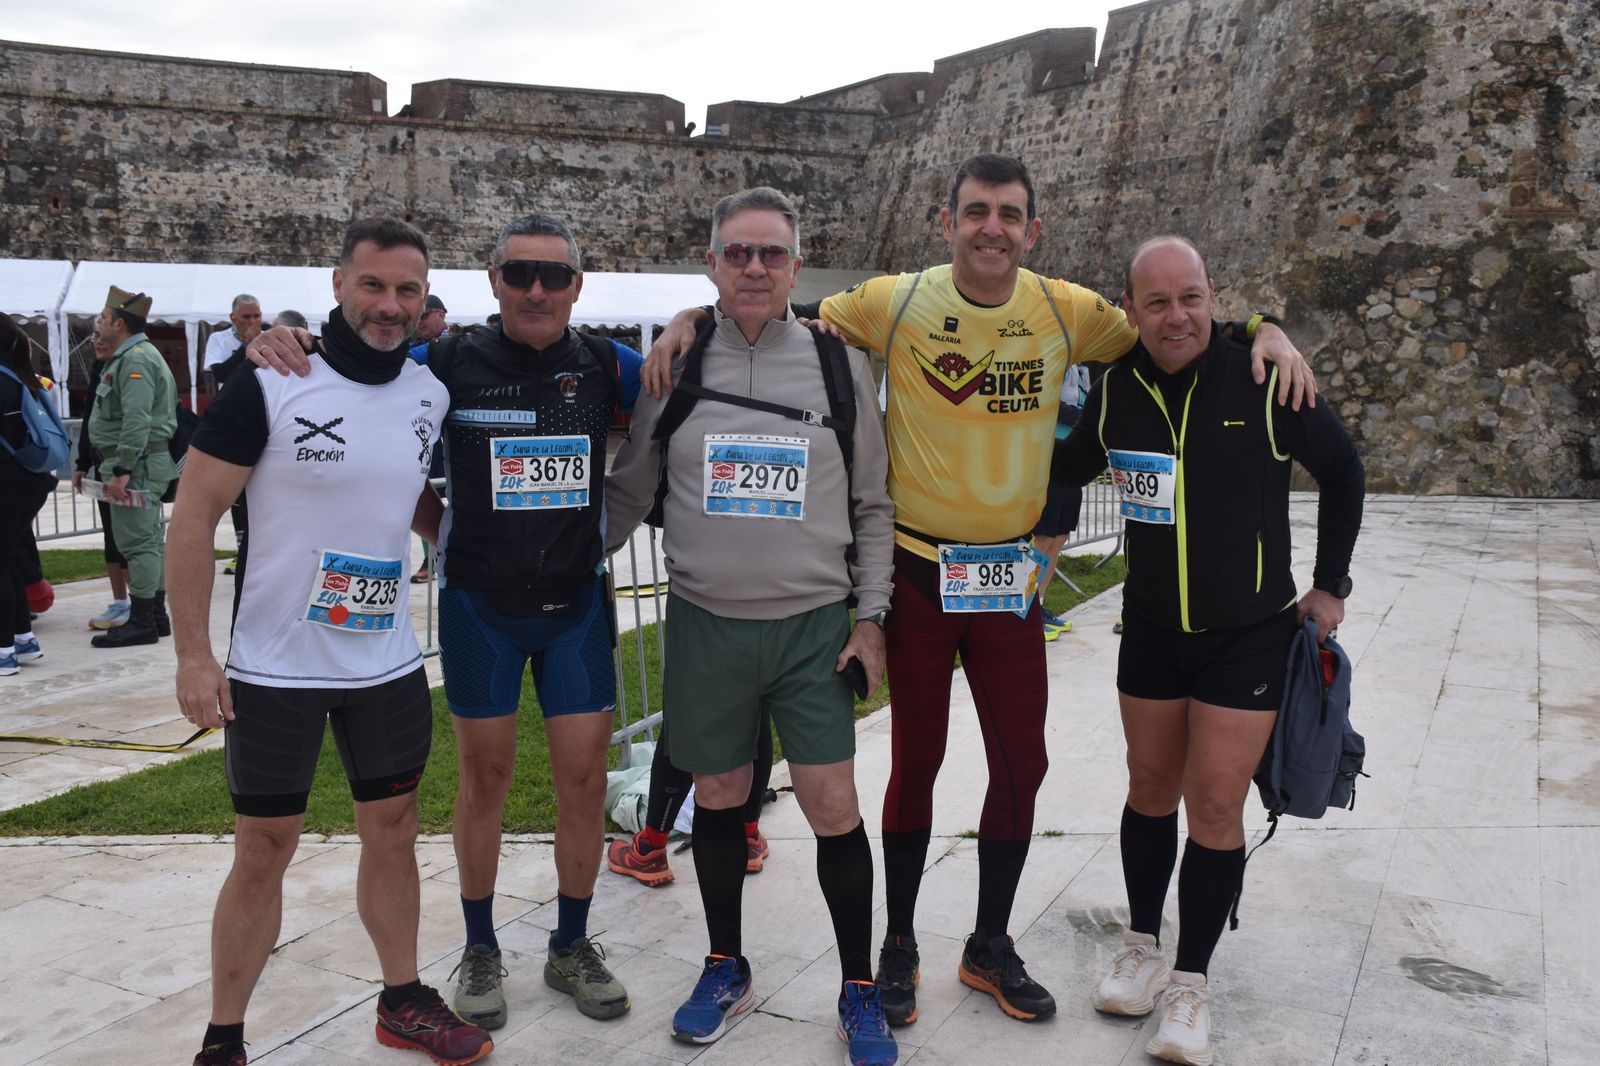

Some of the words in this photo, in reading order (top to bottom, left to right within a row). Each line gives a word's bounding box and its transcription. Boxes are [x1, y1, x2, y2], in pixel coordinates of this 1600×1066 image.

[928, 332, 961, 345] BALEARIA
[997, 327, 1035, 338] Zurita
[994, 358, 1045, 372] TITANES
[978, 370, 1044, 396] BIKE
[986, 396, 1040, 414] CEUTA
[529, 456, 584, 482] 3678
[500, 476, 526, 489] 20K
[739, 464, 799, 492] 2970
[710, 480, 736, 493] 20K
[978, 563, 1014, 587] 985
[352, 578, 398, 605] 3235
[945, 580, 970, 593] 20K
